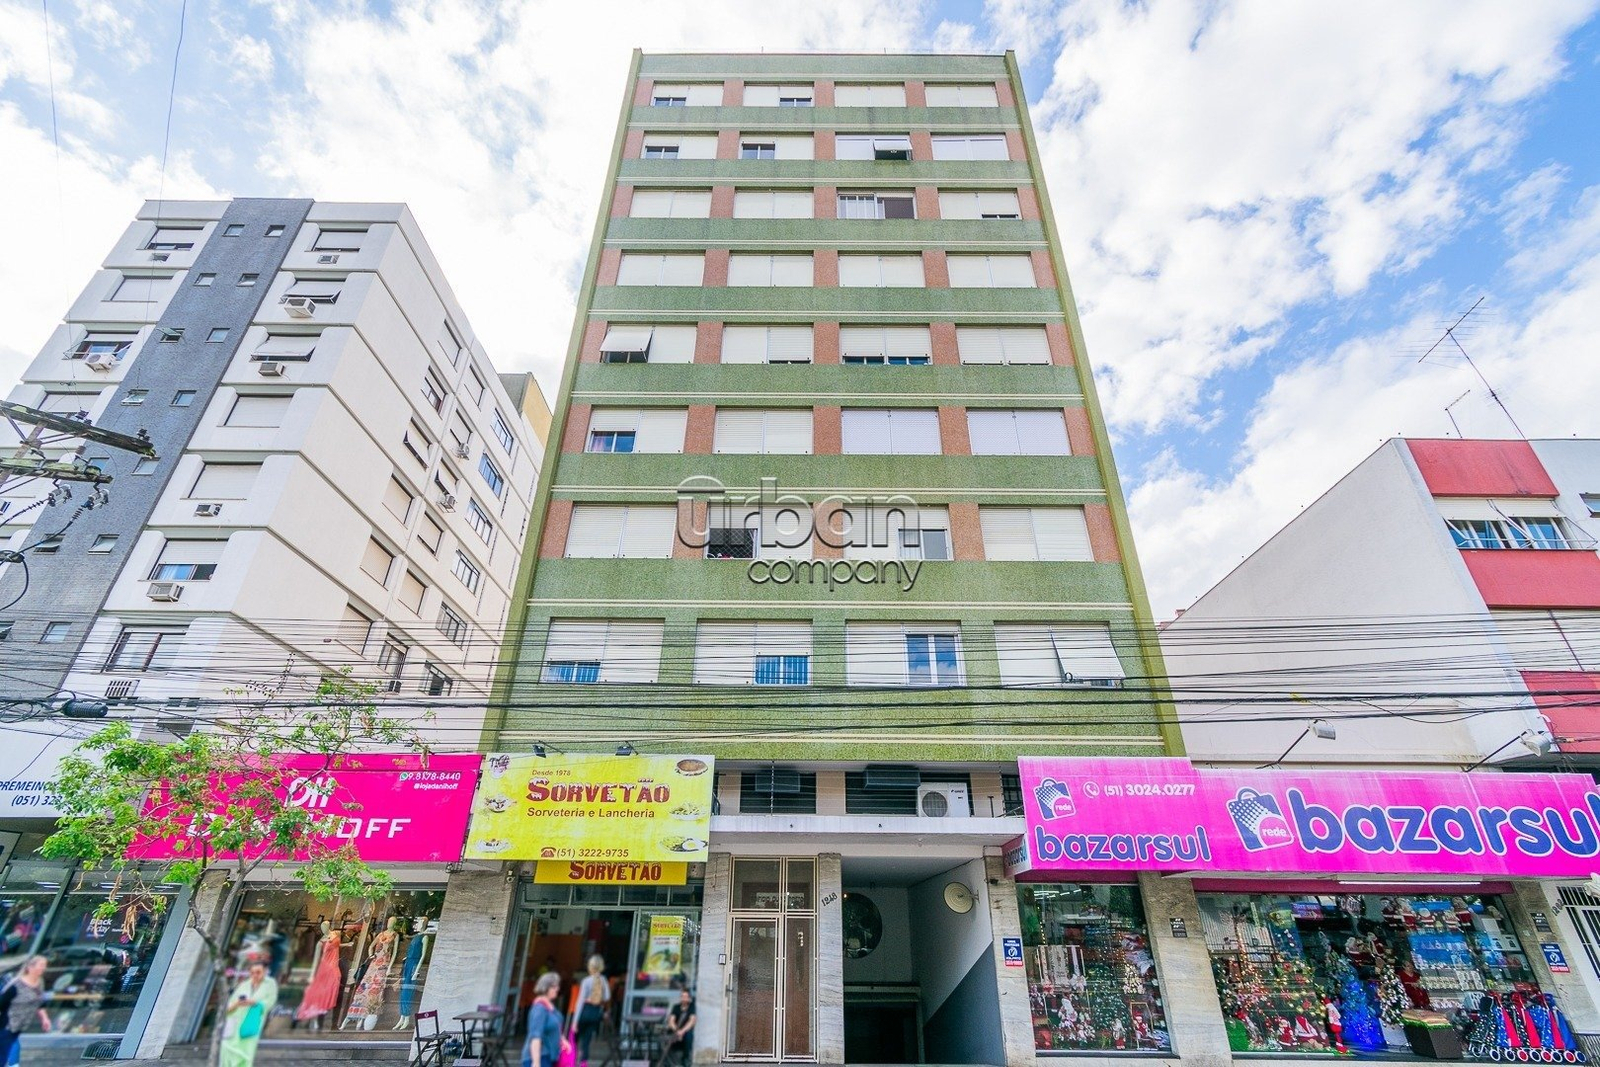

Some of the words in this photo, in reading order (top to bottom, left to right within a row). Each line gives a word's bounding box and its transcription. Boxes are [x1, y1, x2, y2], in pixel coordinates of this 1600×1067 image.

[526, 777, 671, 803] SORVETÃO
[1104, 784, 1124, 797] (51)
[1126, 784, 1196, 797] 3024.0277
[11, 795, 40, 807] (051)
[527, 807, 585, 817] Sorveteria
[588, 810, 595, 818] e
[599, 808, 655, 818] Lancheria
[1055, 803, 1072, 812] rede
[1262, 826, 1287, 838] rede
[1035, 825, 1211, 861] bazarsul
[556, 848, 576, 859] (51)
[578, 849, 629, 858] 3222-9735
